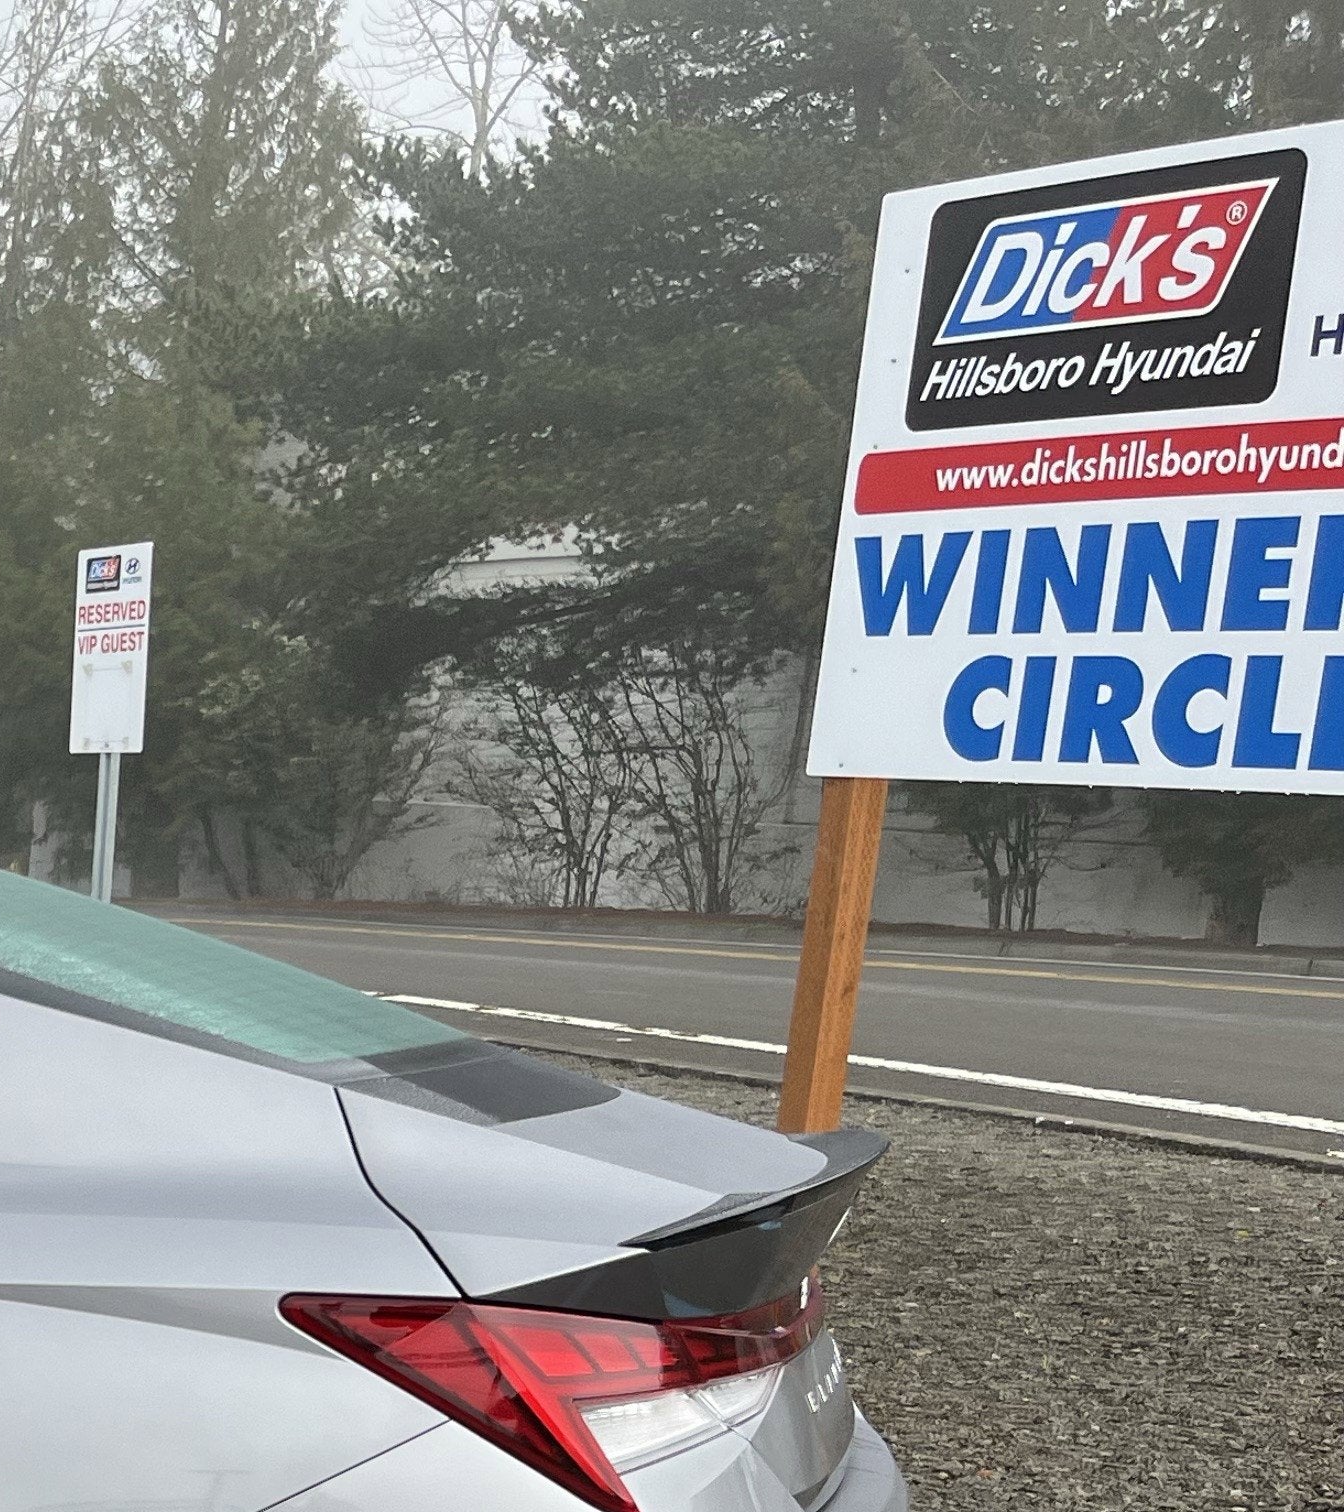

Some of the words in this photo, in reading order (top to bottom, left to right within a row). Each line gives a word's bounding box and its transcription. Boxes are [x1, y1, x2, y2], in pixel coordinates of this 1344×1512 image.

[920, 352, 1086, 401] Hillsboro
[1089, 328, 1262, 394] Hyundai
[78, 600, 146, 625] RESERVED
[78, 634, 97, 655] VIP
[101, 631, 145, 653] GUEST
